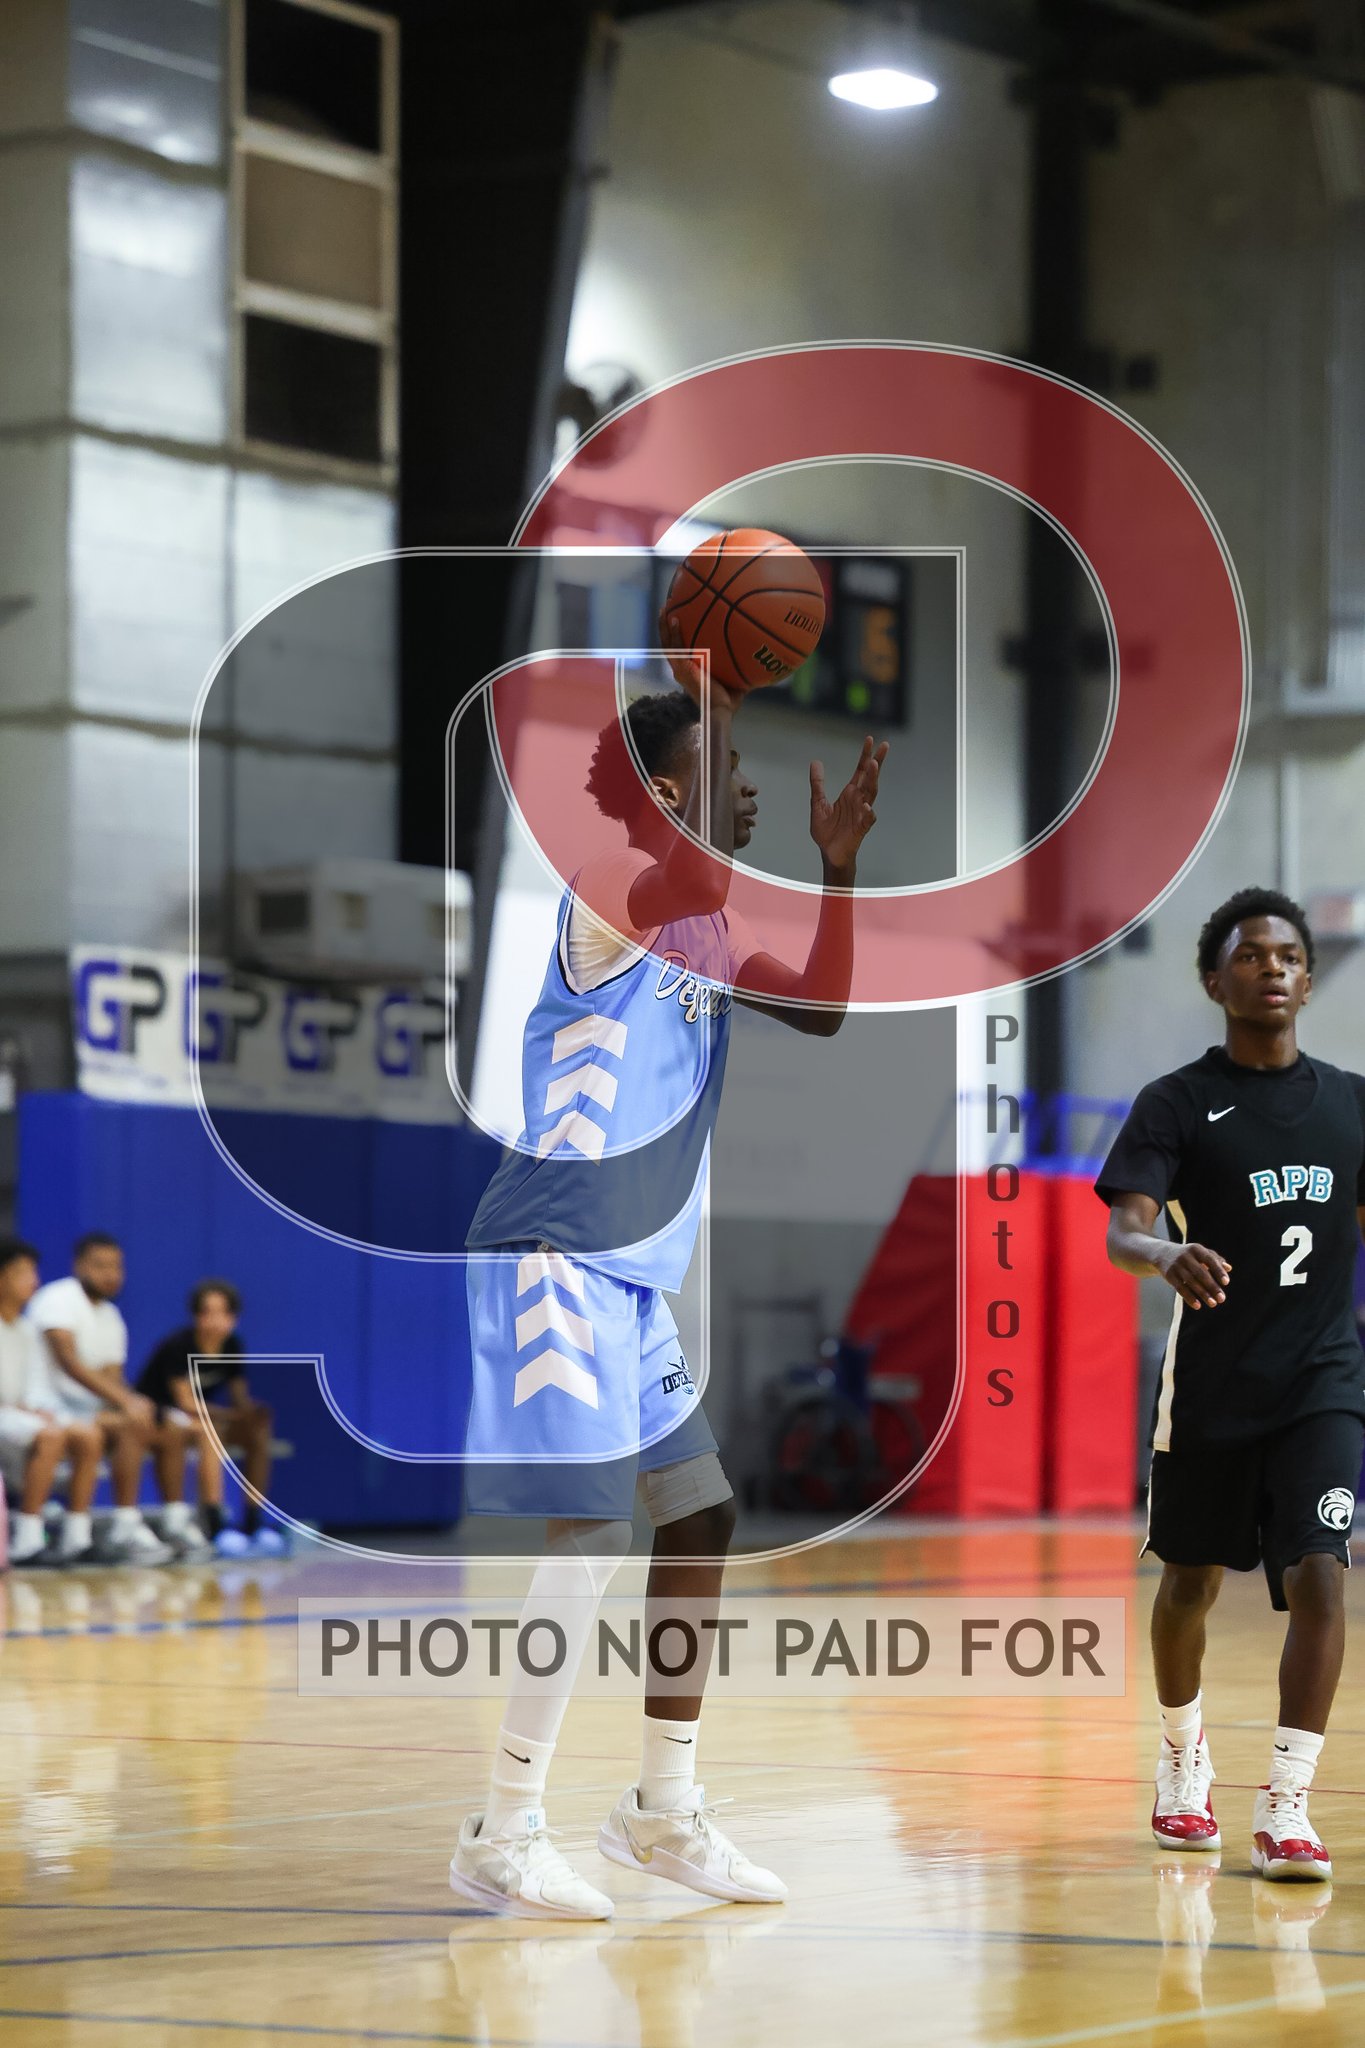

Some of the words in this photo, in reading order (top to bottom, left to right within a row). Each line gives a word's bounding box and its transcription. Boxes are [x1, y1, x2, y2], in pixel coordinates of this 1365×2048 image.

[76, 960, 165, 1053] GP
[1249, 1165, 1334, 1207] RPB
[1279, 1225, 1313, 1287] 2
